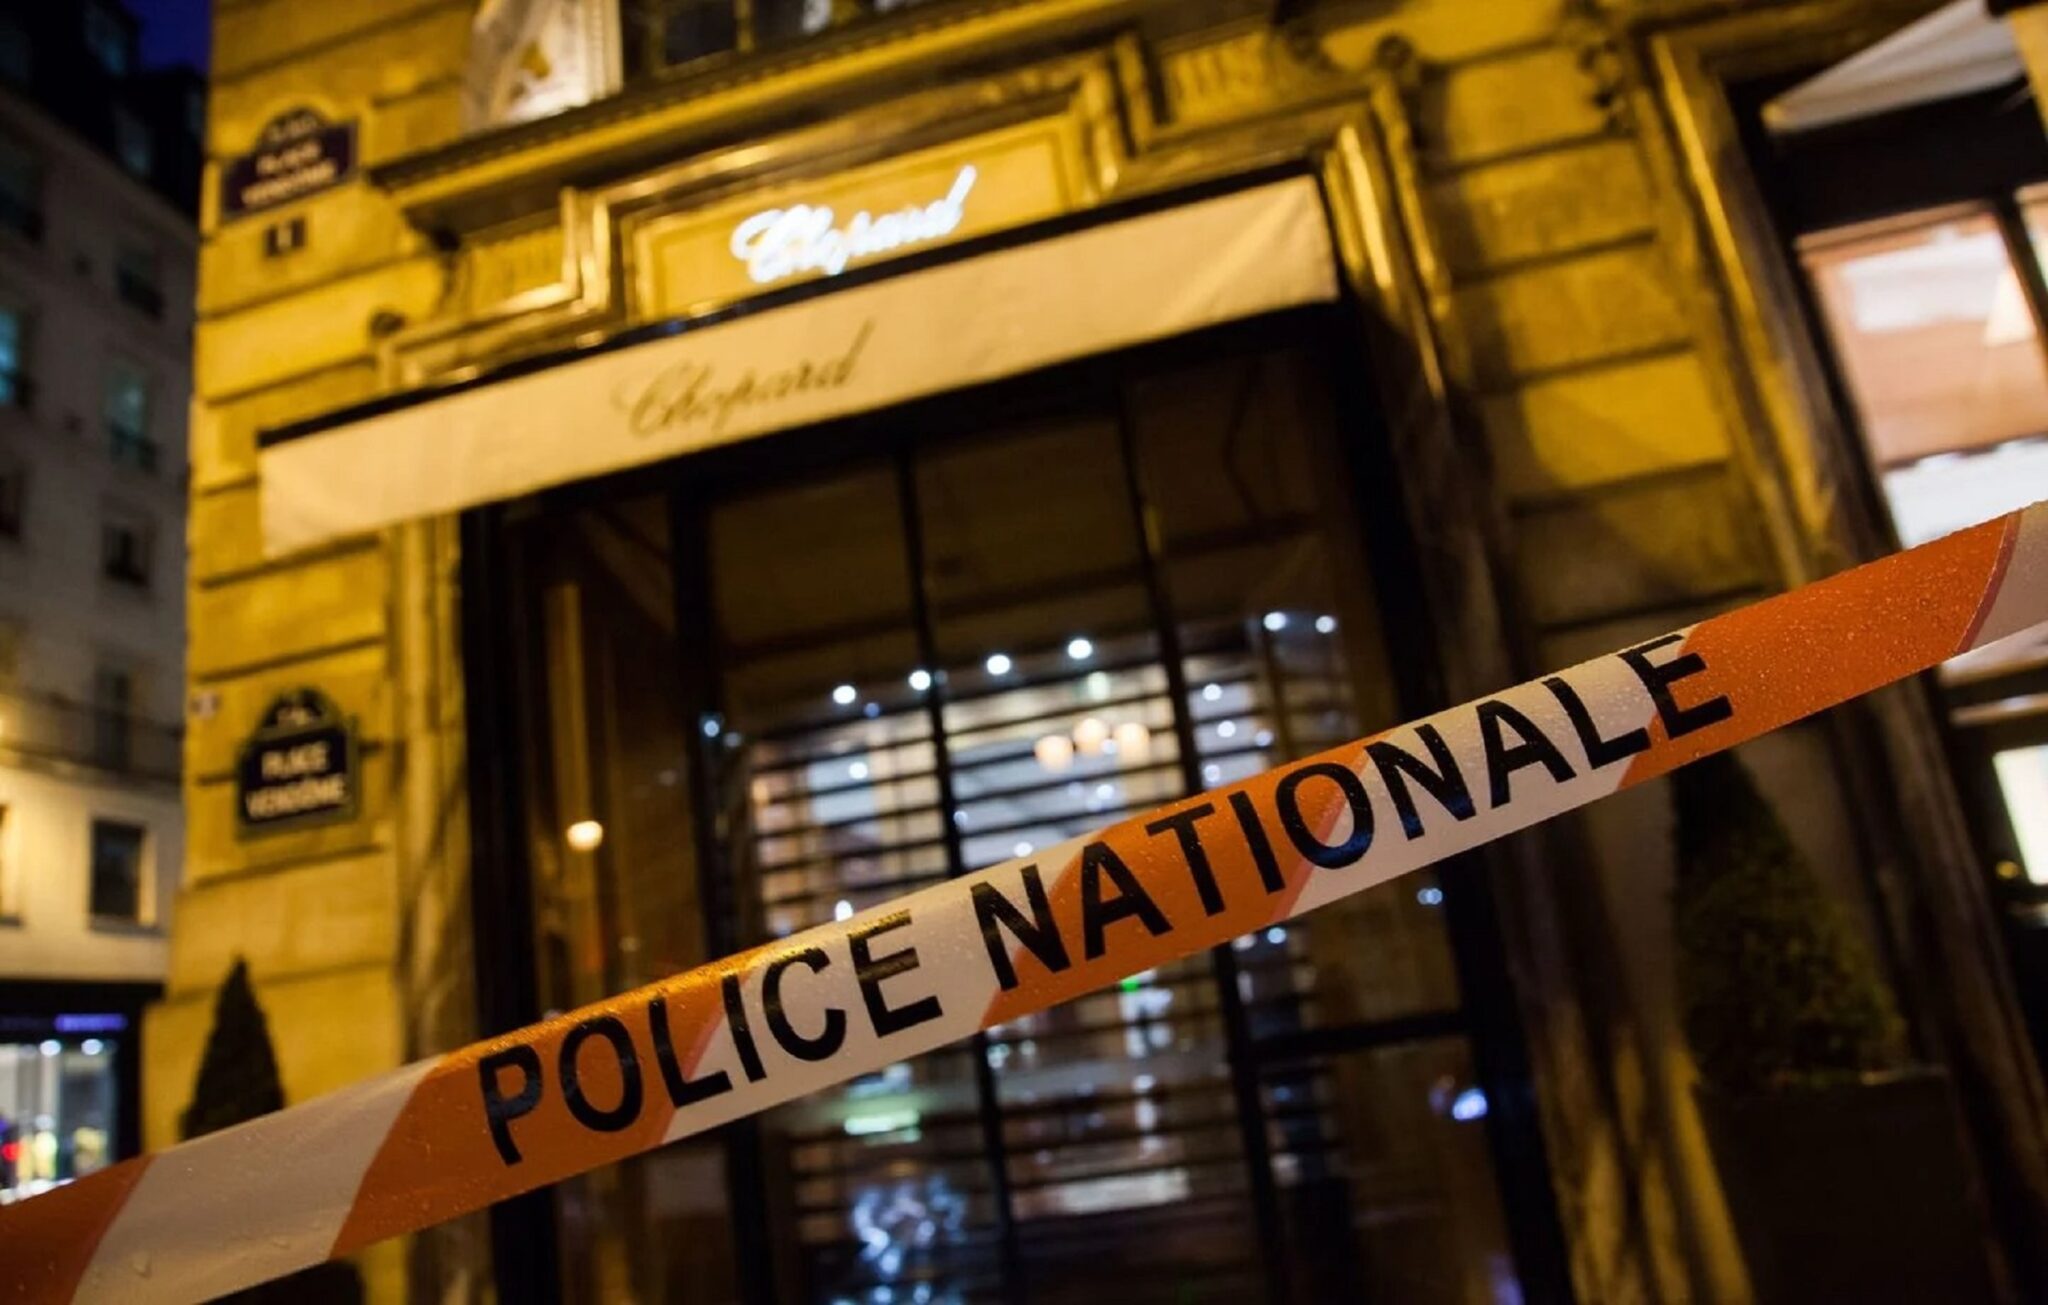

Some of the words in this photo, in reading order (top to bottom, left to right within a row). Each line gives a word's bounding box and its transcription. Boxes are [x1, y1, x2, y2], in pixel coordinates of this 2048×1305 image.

[729, 163, 978, 284] Chopard
[611, 314, 876, 438] Chopard
[478, 908, 943, 1166] POLICE
[969, 634, 1733, 991] NATIONALE
